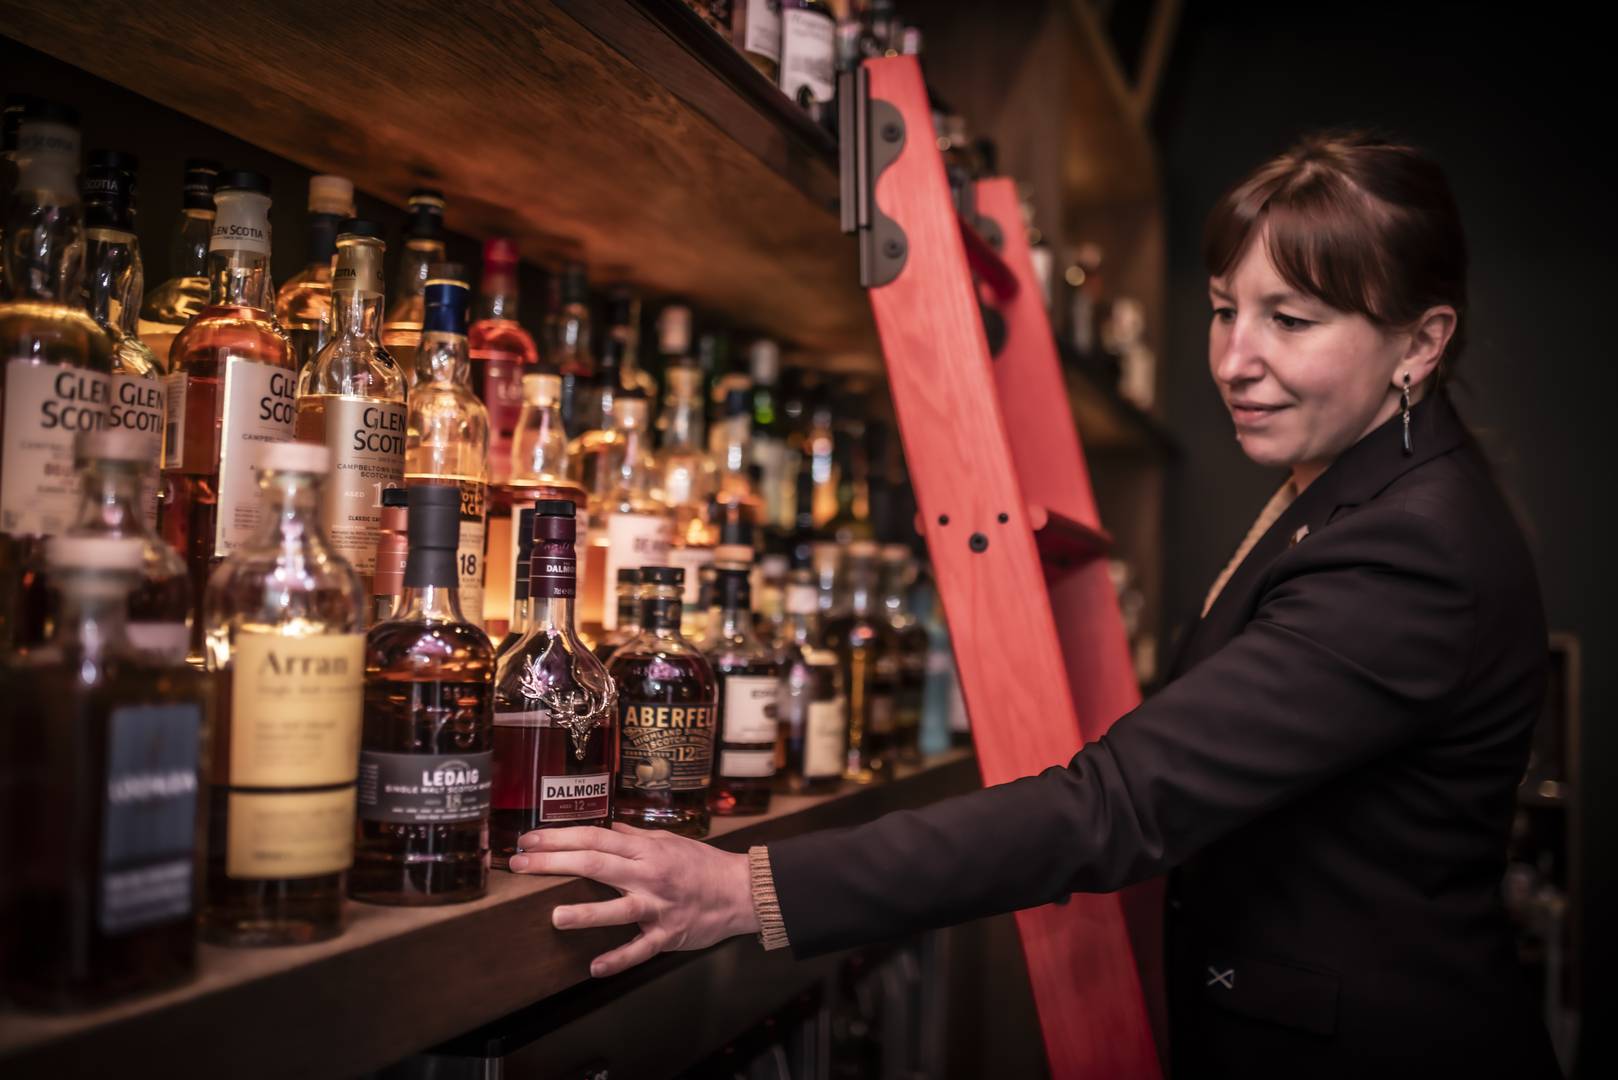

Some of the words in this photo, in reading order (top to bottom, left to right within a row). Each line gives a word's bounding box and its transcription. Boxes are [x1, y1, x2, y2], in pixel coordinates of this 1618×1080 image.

[229, 224, 264, 239] SCOTIA
[270, 373, 296, 399] GLE
[41, 400, 107, 432] SCOT
[260, 397, 295, 424] SCO
[363, 406, 406, 432] GLEN
[353, 429, 405, 454] SCOTI
[460, 553, 477, 576] 18
[546, 564, 576, 574] DALMO
[258, 650, 349, 676] Arran
[624, 705, 715, 728] ABERFEL
[677, 746, 696, 762] 12
[422, 768, 480, 788] LEDAIG
[546, 782, 607, 799] DALMORE
[574, 800, 585, 811] 12
